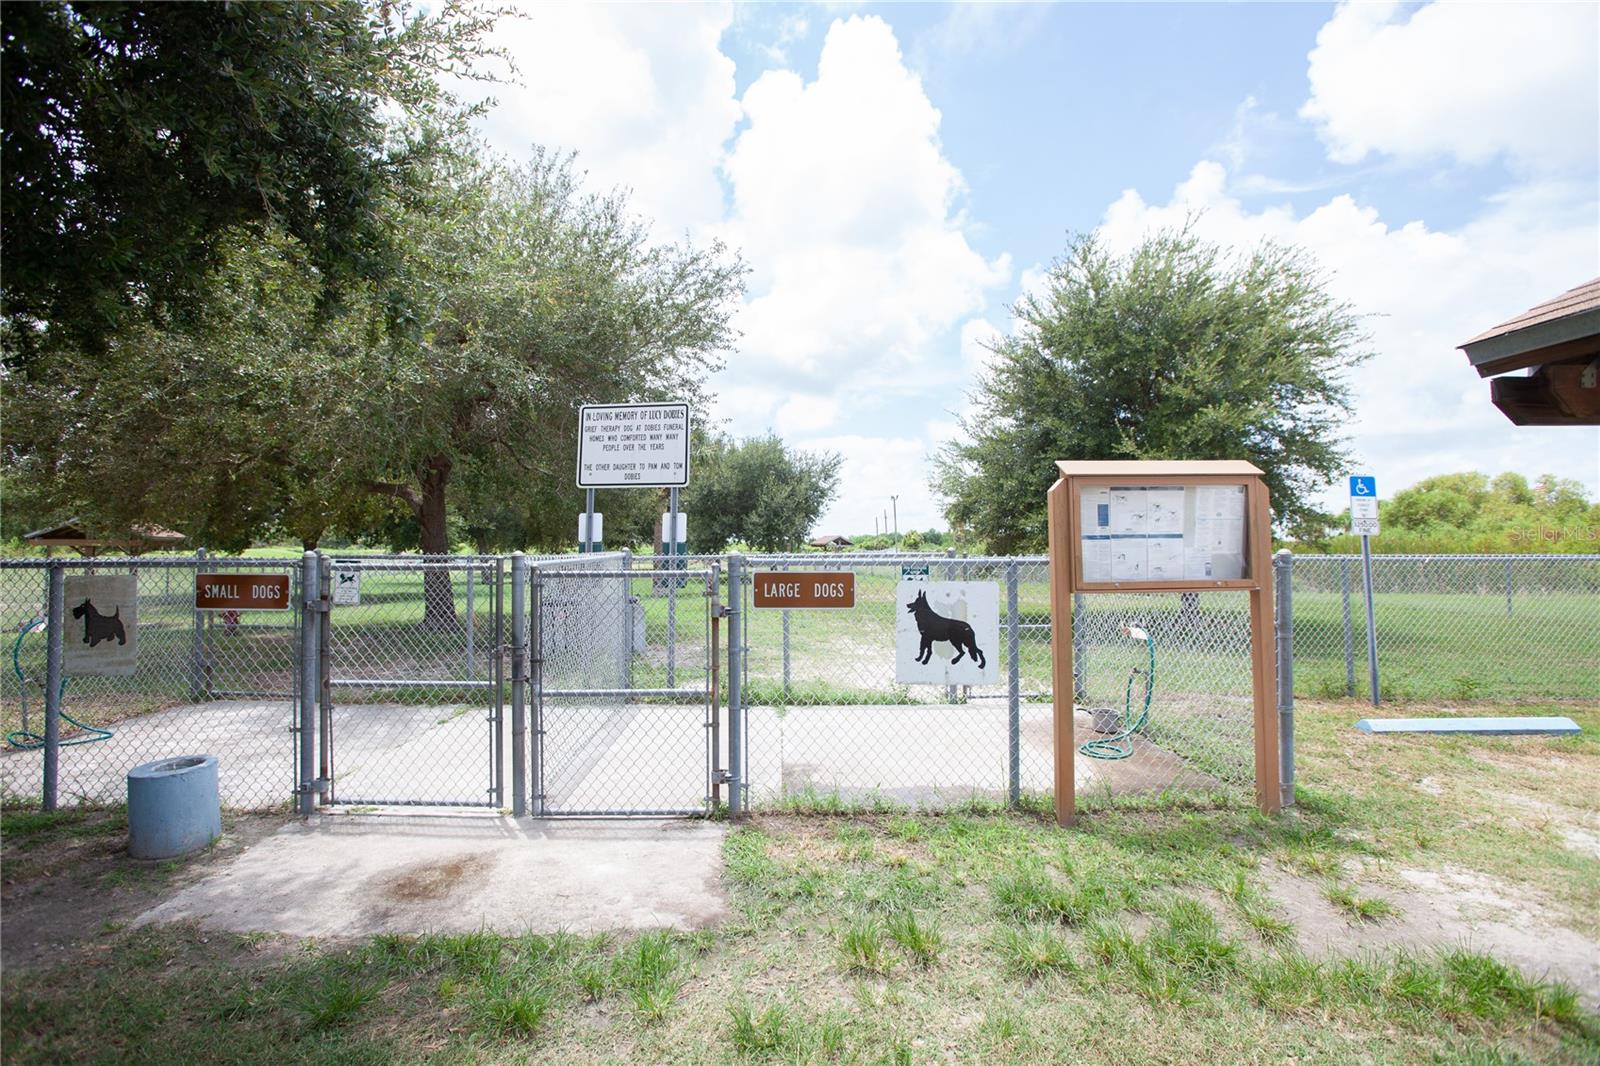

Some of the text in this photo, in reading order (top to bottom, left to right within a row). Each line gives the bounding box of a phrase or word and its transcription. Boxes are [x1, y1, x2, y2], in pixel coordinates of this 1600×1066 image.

[586, 410, 684, 421] IN LOVING MEMORY OF LUCY DOBIES
[205, 585, 280, 598] SMALL DOGS
[764, 583, 844, 597] LARGE DOGS
